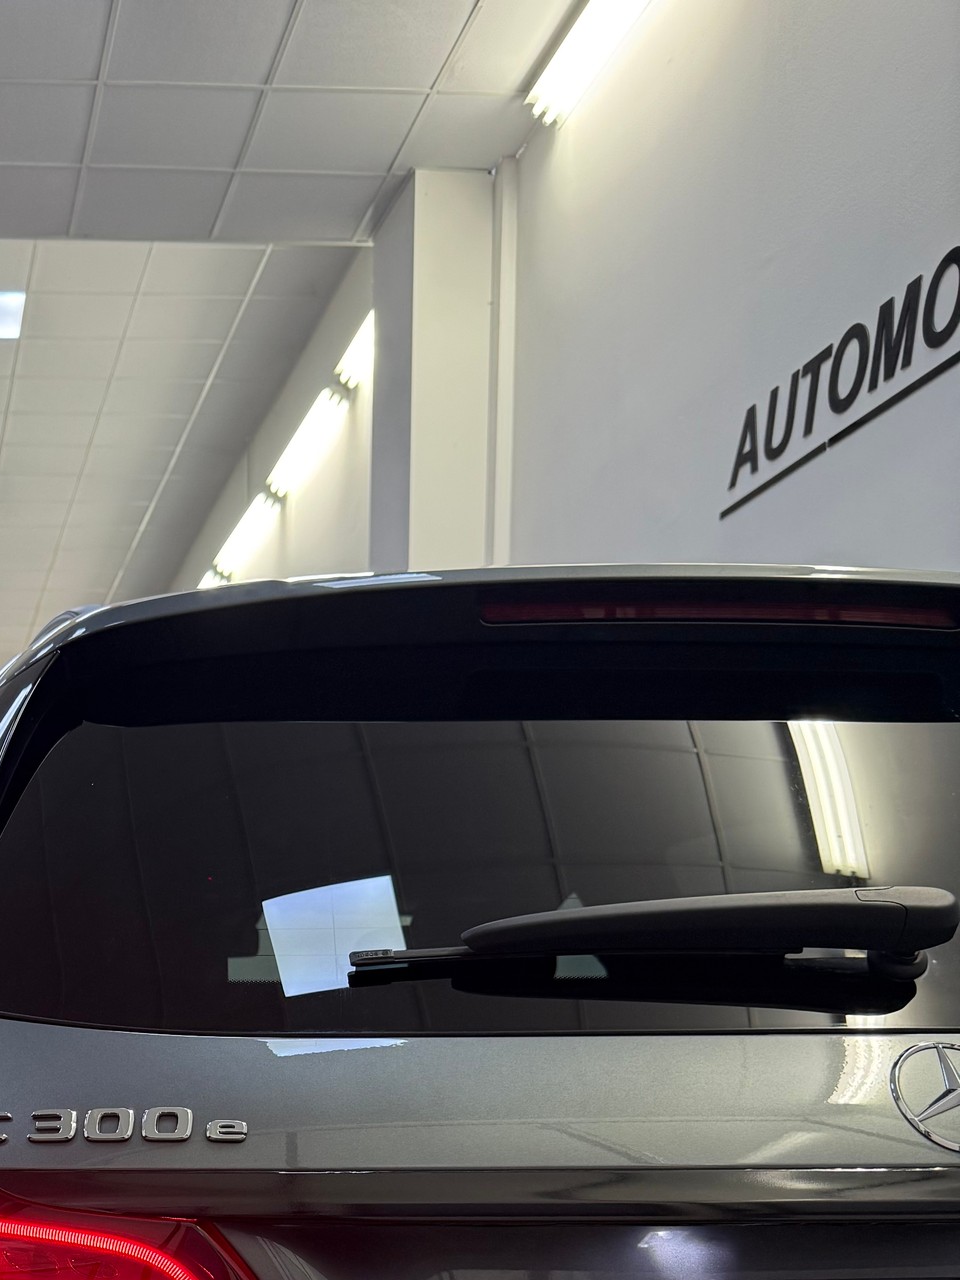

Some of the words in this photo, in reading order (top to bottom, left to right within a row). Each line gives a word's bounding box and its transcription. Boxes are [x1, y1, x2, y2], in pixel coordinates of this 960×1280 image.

[727, 245, 960, 491] AUTOMO
[26, 1106, 194, 1142] 300
[206, 1119, 248, 1142] e
